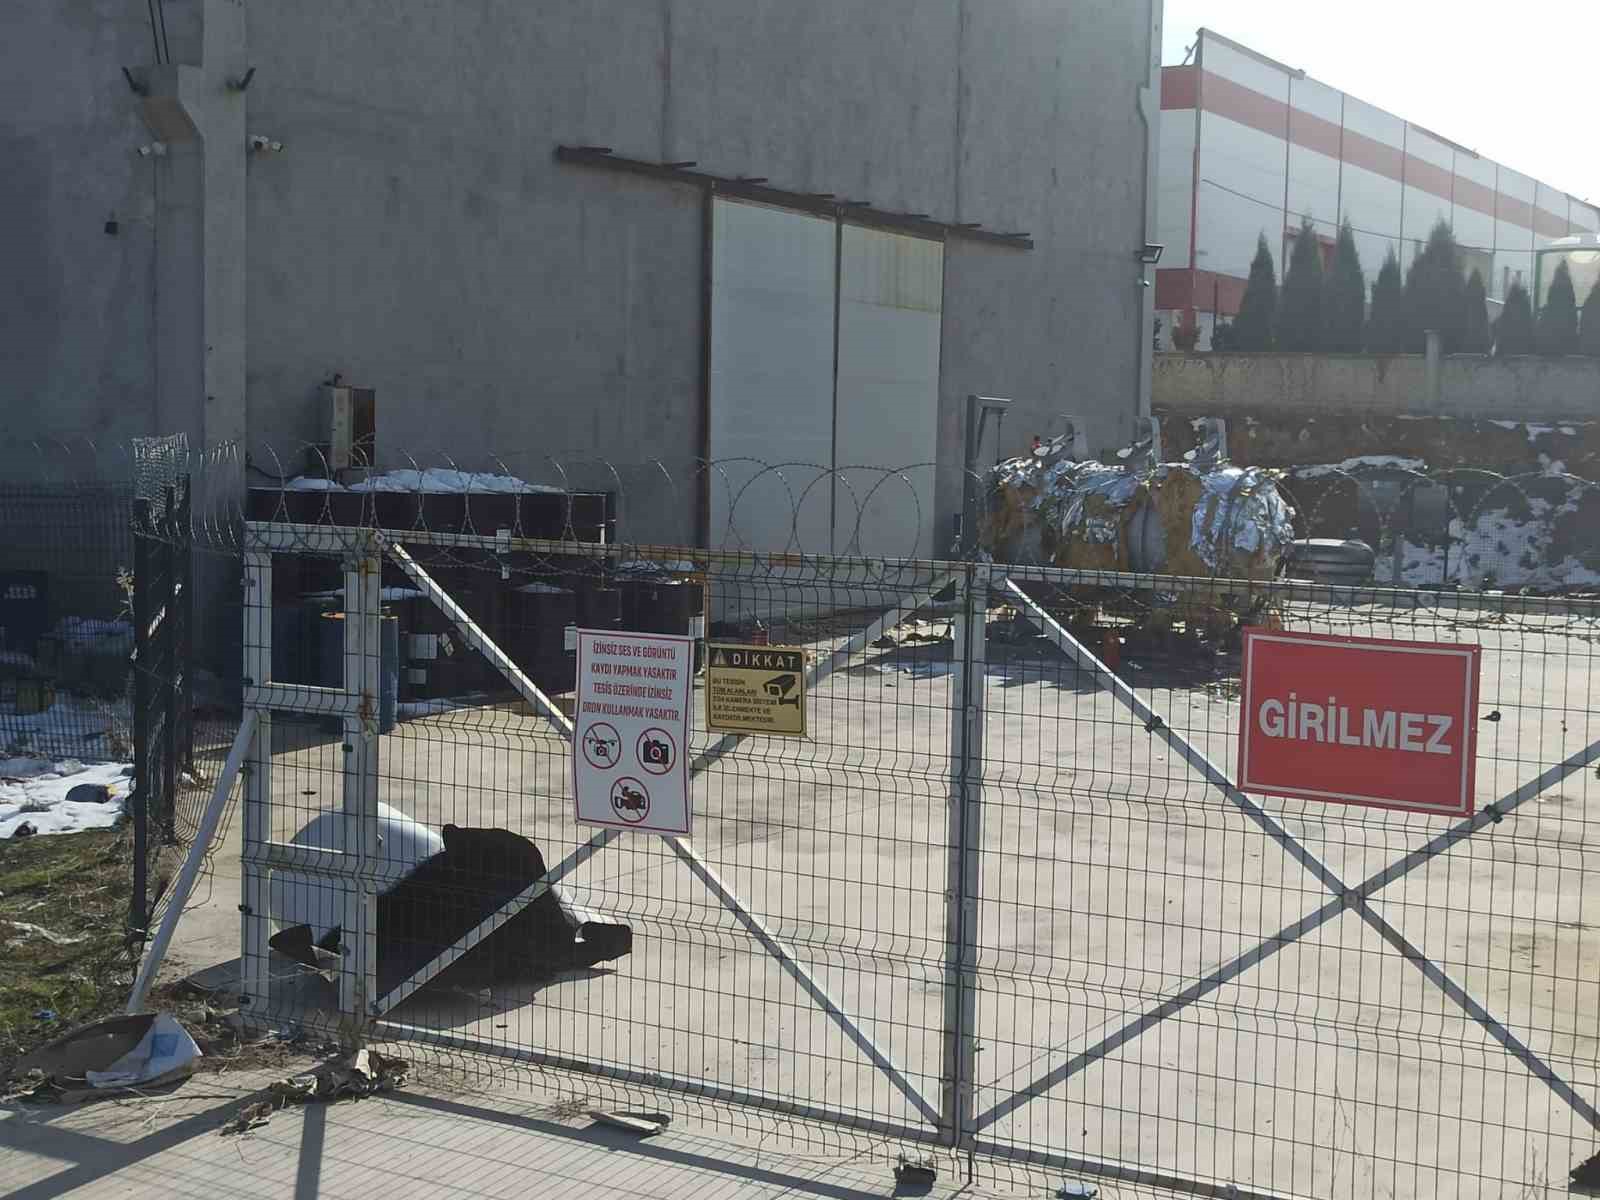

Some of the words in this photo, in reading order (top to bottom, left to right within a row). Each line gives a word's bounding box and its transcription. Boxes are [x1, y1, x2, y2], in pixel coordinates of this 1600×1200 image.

[632, 646, 641, 657] VE
[733, 652, 796, 668] DİKKAT
[591, 663, 611, 675] KAYDI
[613, 664, 641, 677] YAPMAK
[583, 702, 601, 713] DRON
[602, 703, 644, 718] KULLANMAK
[1259, 692, 1452, 754] GİRİLMEZ
